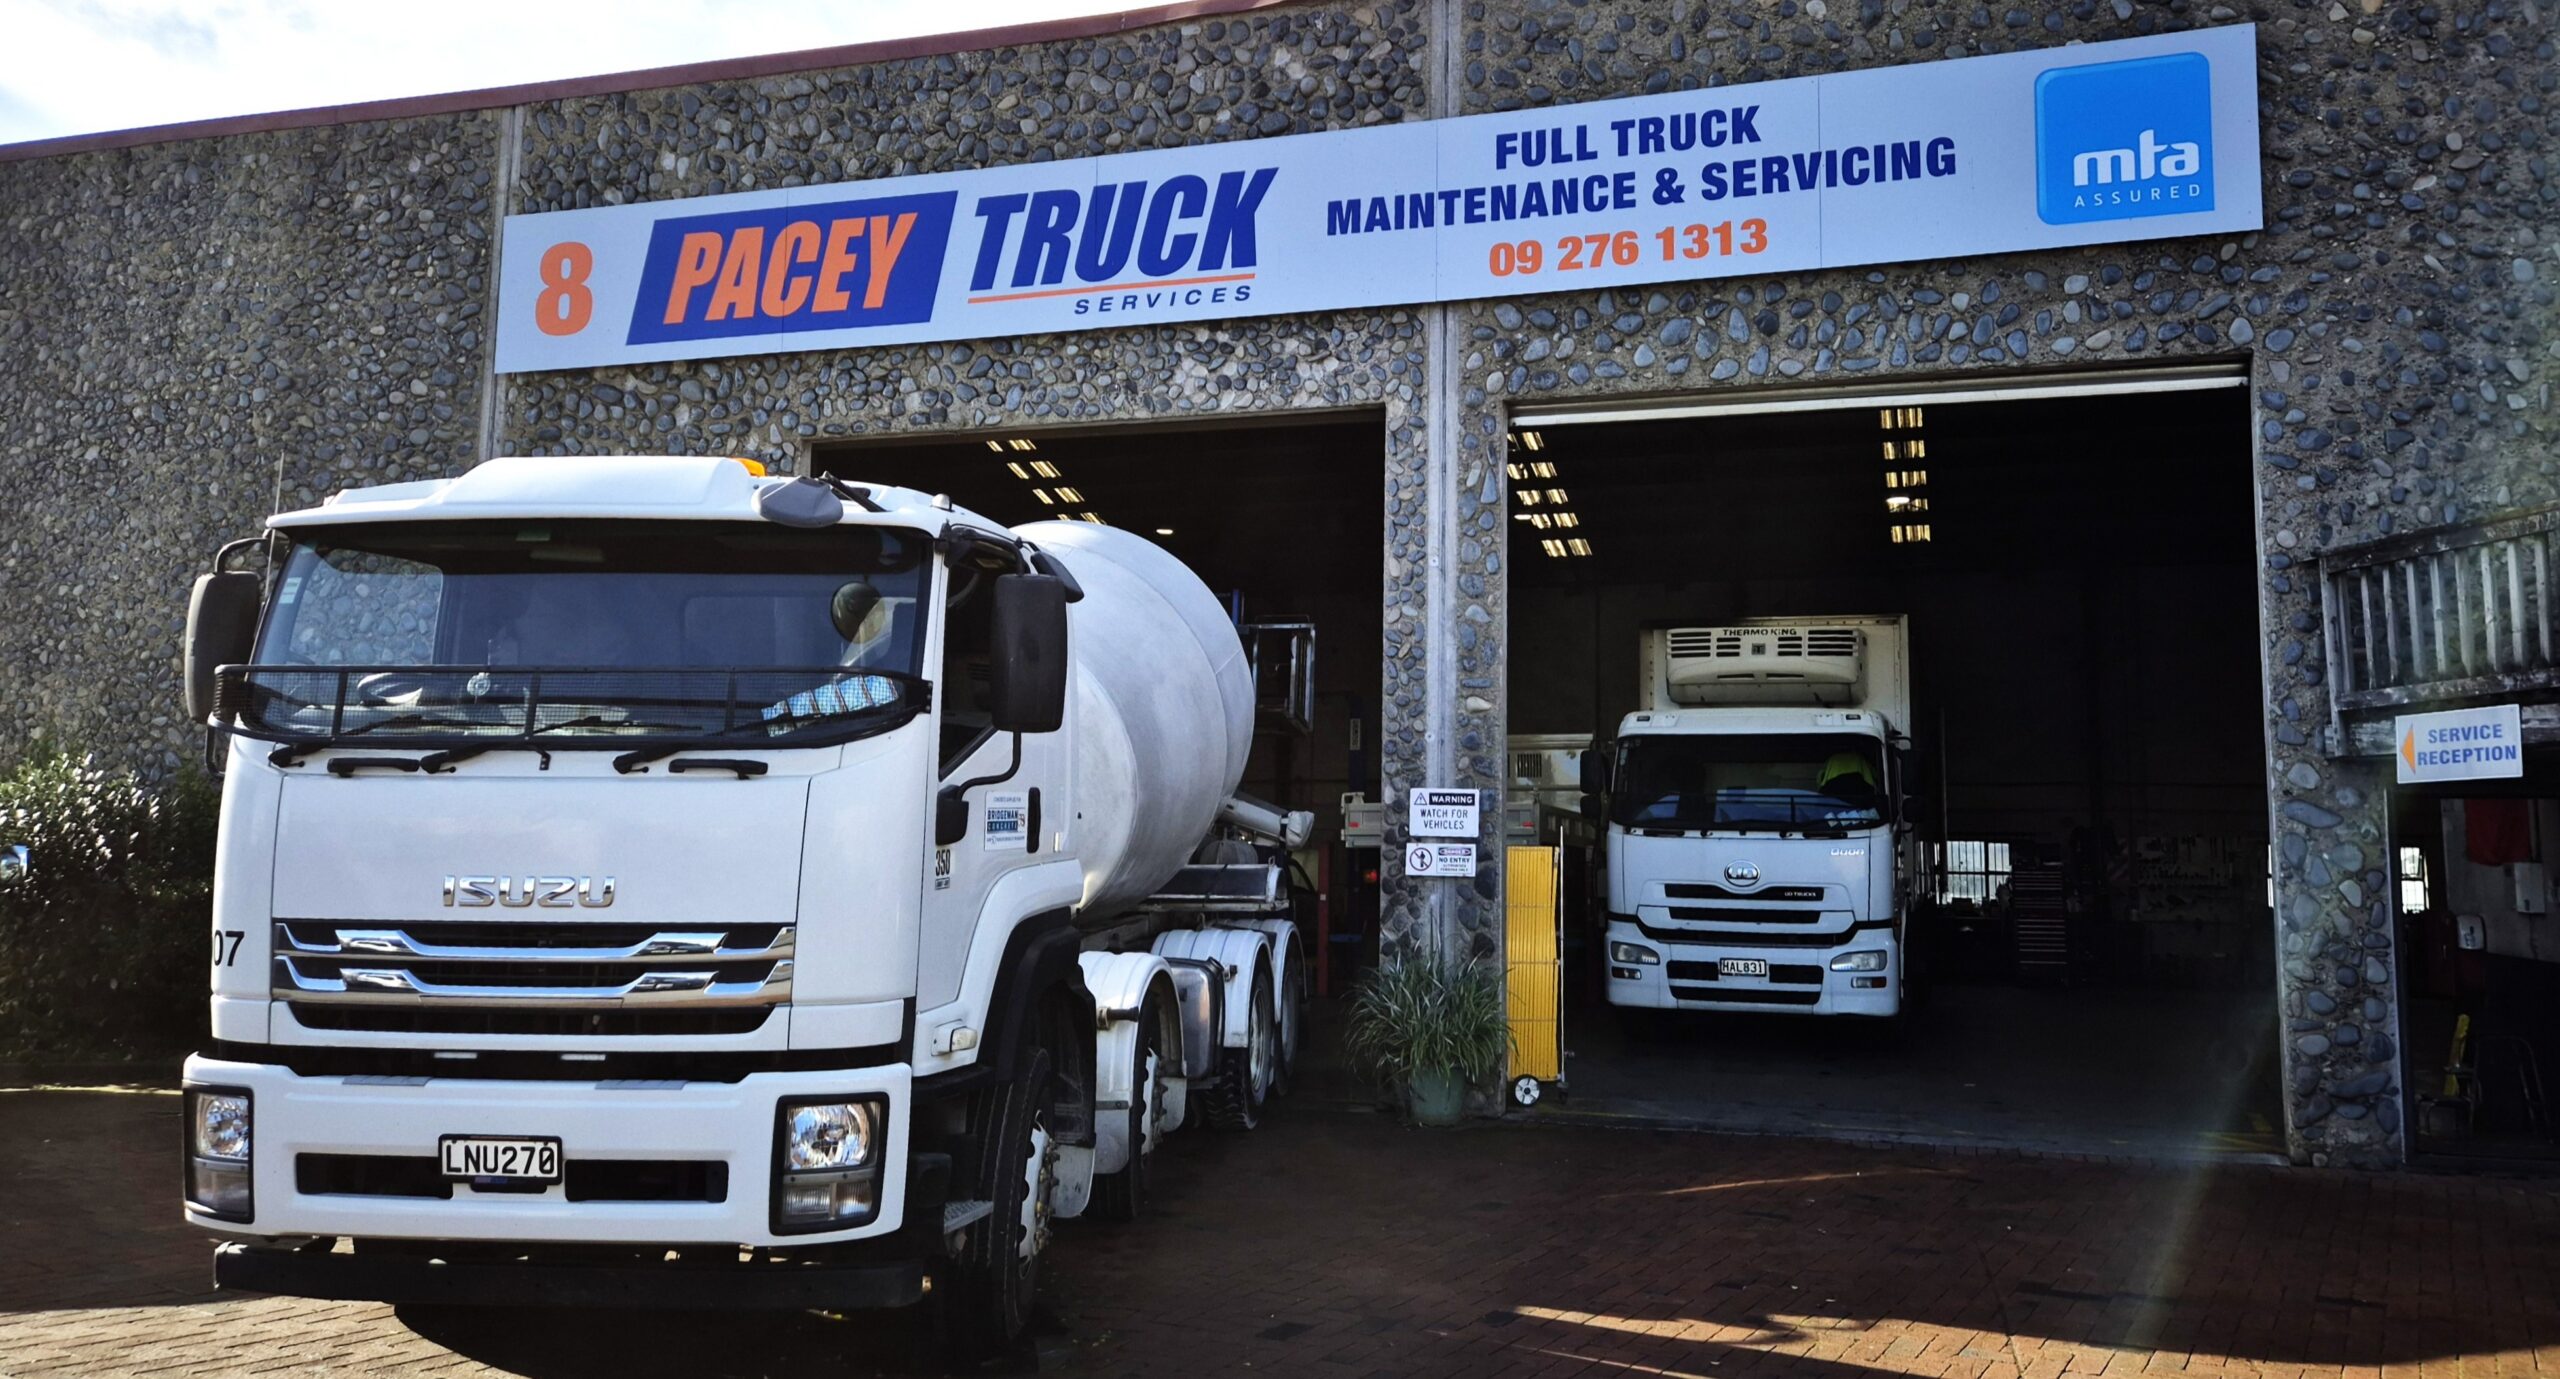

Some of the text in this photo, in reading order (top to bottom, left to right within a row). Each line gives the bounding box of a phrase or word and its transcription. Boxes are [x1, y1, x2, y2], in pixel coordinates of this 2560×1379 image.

[1496, 105, 1762, 170] FULL TRUCK
[2073, 129, 2200, 187] mta
[1327, 136, 1957, 236] MAINTENANCE & SERVICING
[2074, 184, 2201, 208] ASSURED
[969, 167, 1280, 291] TRUCK
[1489, 218, 1769, 277] 09 276 1313
[663, 212, 919, 325] PACEY
[535, 242, 593, 336] 8
[1074, 285, 1251, 315] SERVICES
[1722, 628, 1797, 637] THERMO KING
[2428, 723, 2503, 744] SERVICE
[2417, 745, 2517, 767] RECEPTION
[1420, 808, 1468, 818] WATCH FOR
[1431, 795, 1473, 804] WARNING
[987, 809, 1018, 821] BRIDGEMAN
[1423, 820, 1465, 830] VEHICLES
[935, 848, 951, 877] 350
[441, 874, 617, 908] ISUZU
[213, 930, 246, 967] 07
[1722, 961, 1763, 974] HAL831
[445, 1144, 556, 1175] LNU270
